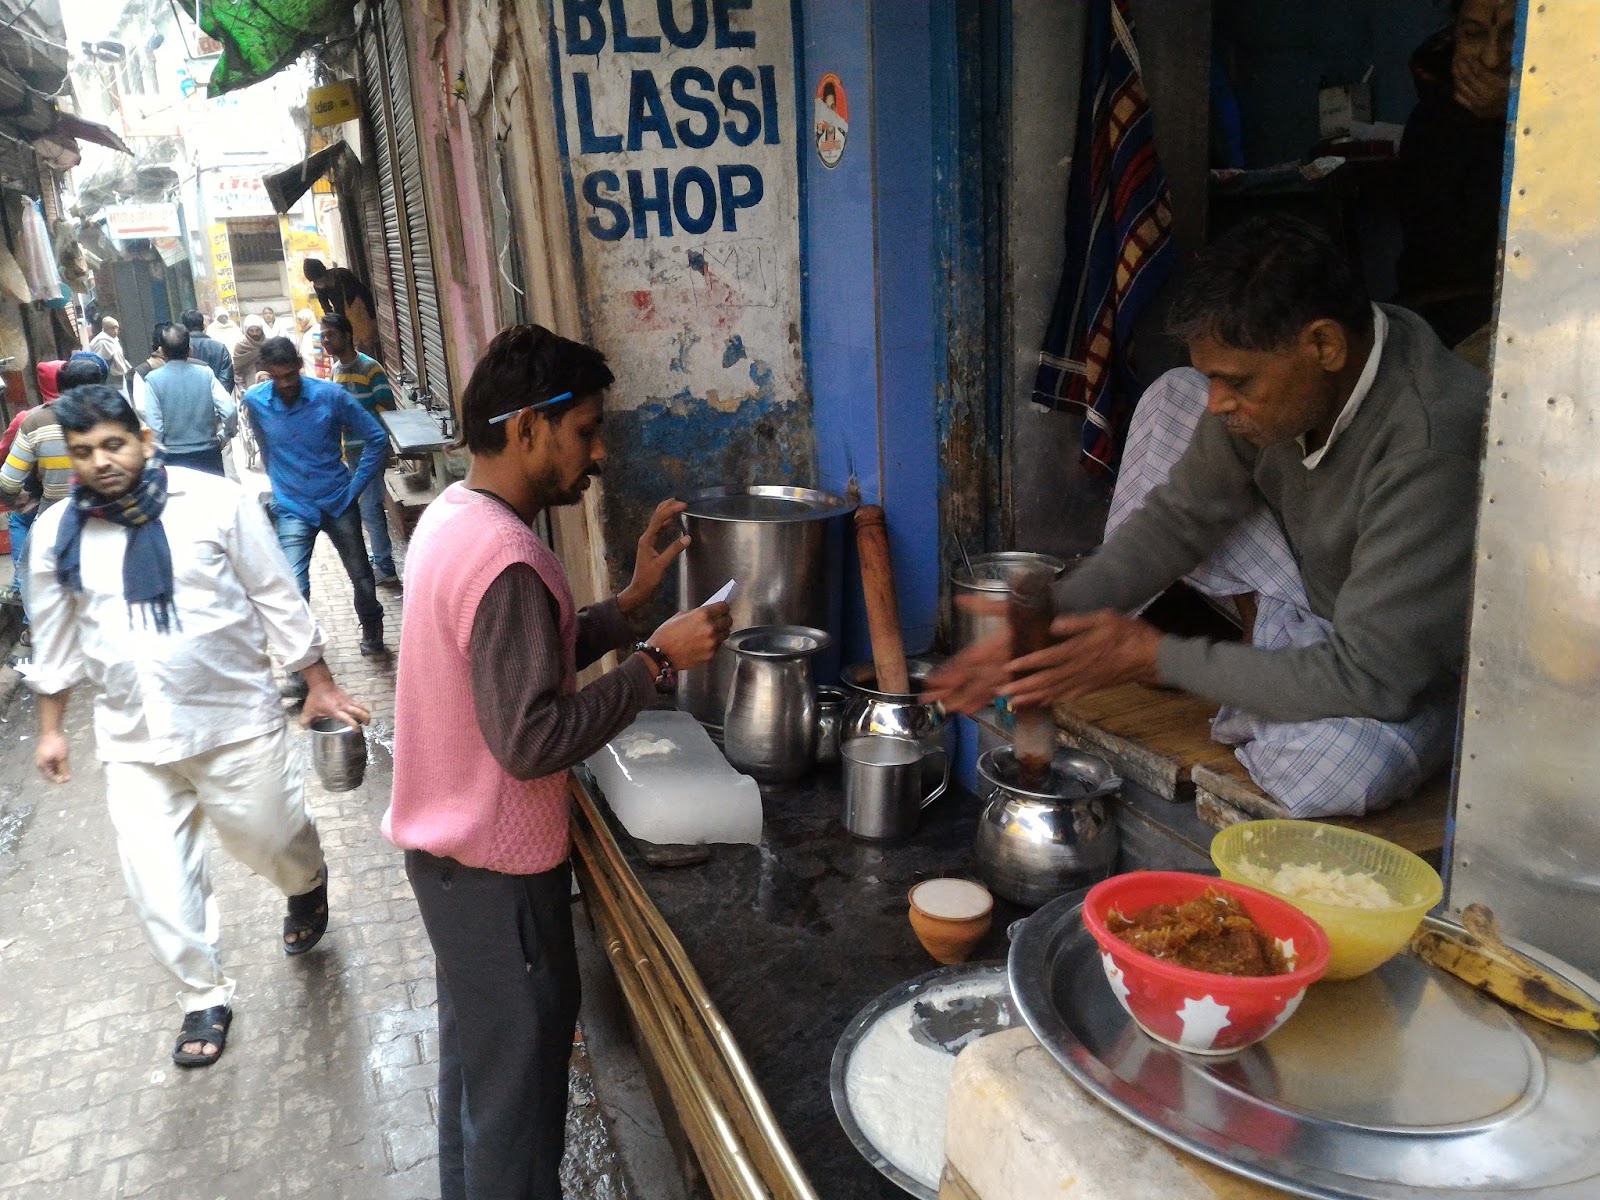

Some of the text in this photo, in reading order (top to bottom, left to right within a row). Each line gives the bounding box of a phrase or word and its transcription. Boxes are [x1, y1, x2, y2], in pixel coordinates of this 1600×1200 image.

[563, 0, 757, 56] BLUE
[572, 65, 782, 155] LASSI
[581, 164, 764, 241] SHOP
